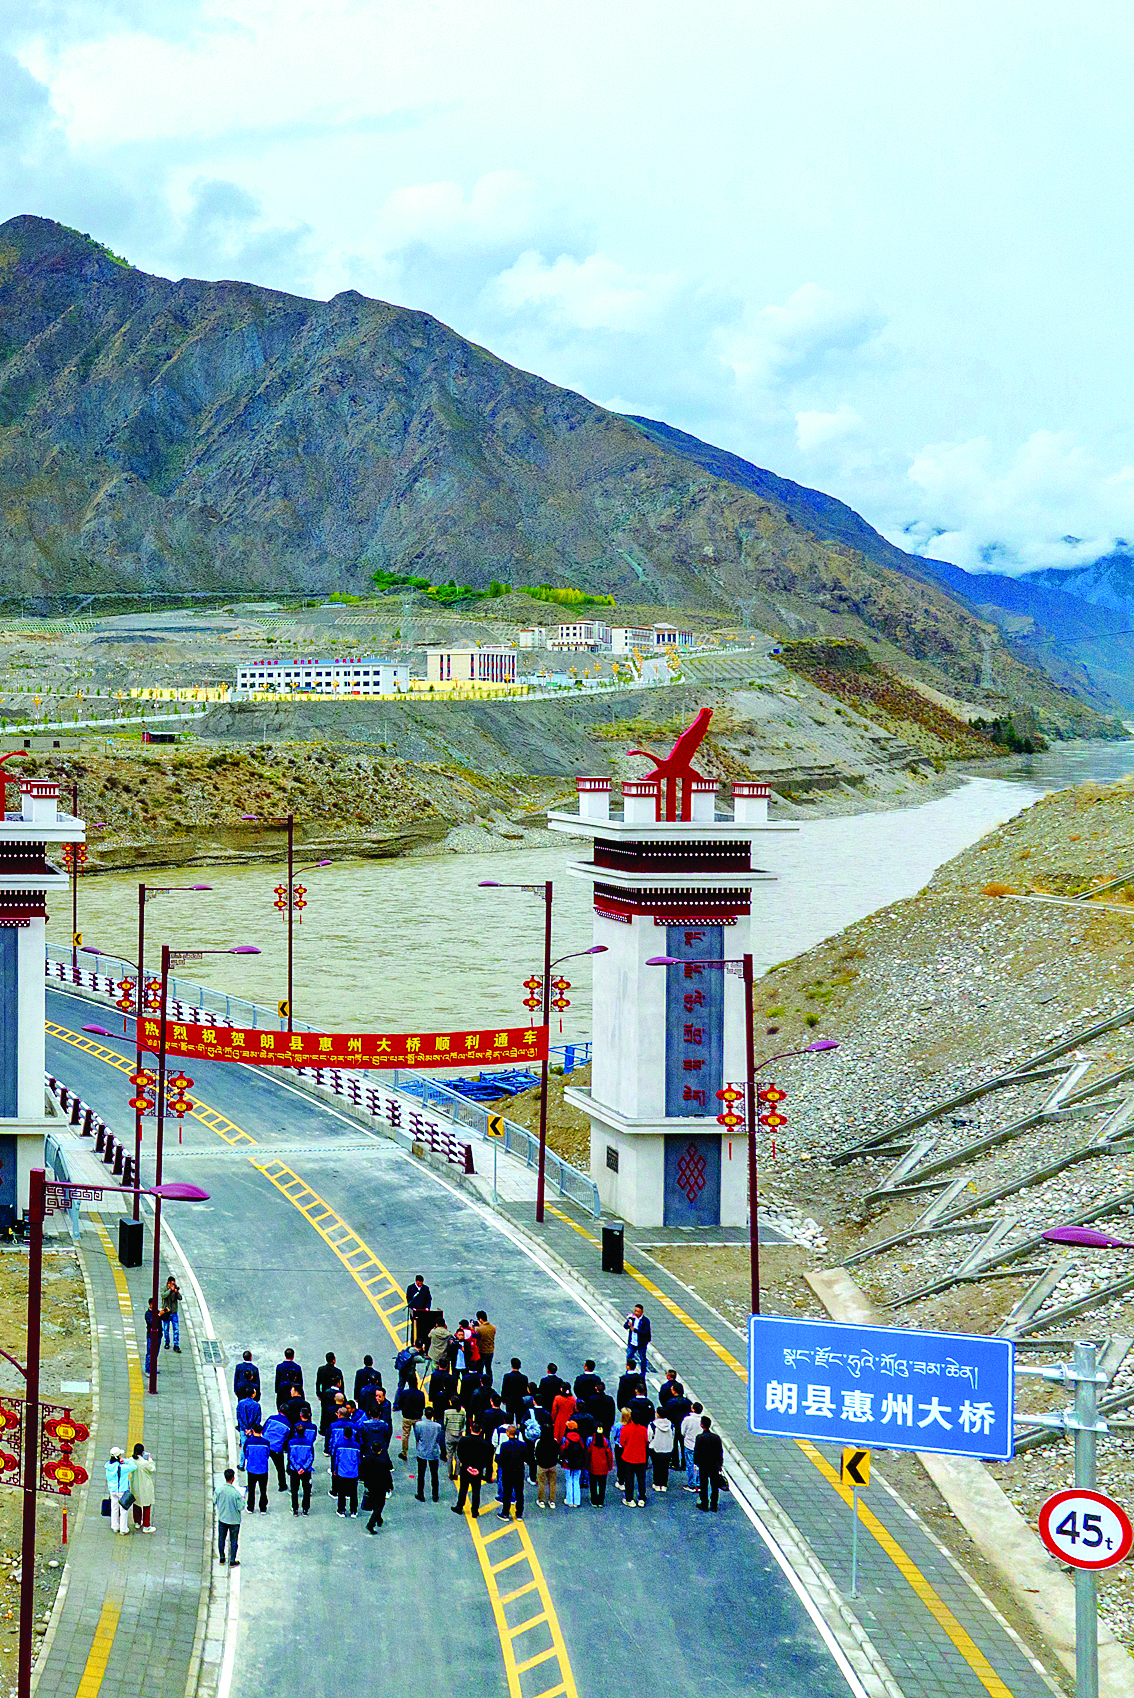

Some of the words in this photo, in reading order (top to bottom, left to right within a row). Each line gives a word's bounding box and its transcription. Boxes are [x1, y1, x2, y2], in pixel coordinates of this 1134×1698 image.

[144, 1020, 537, 1053] 热烈祝贺朗县惠州大桥顺利通车
[765, 1380, 996, 1435] 朗县惠州大桥
